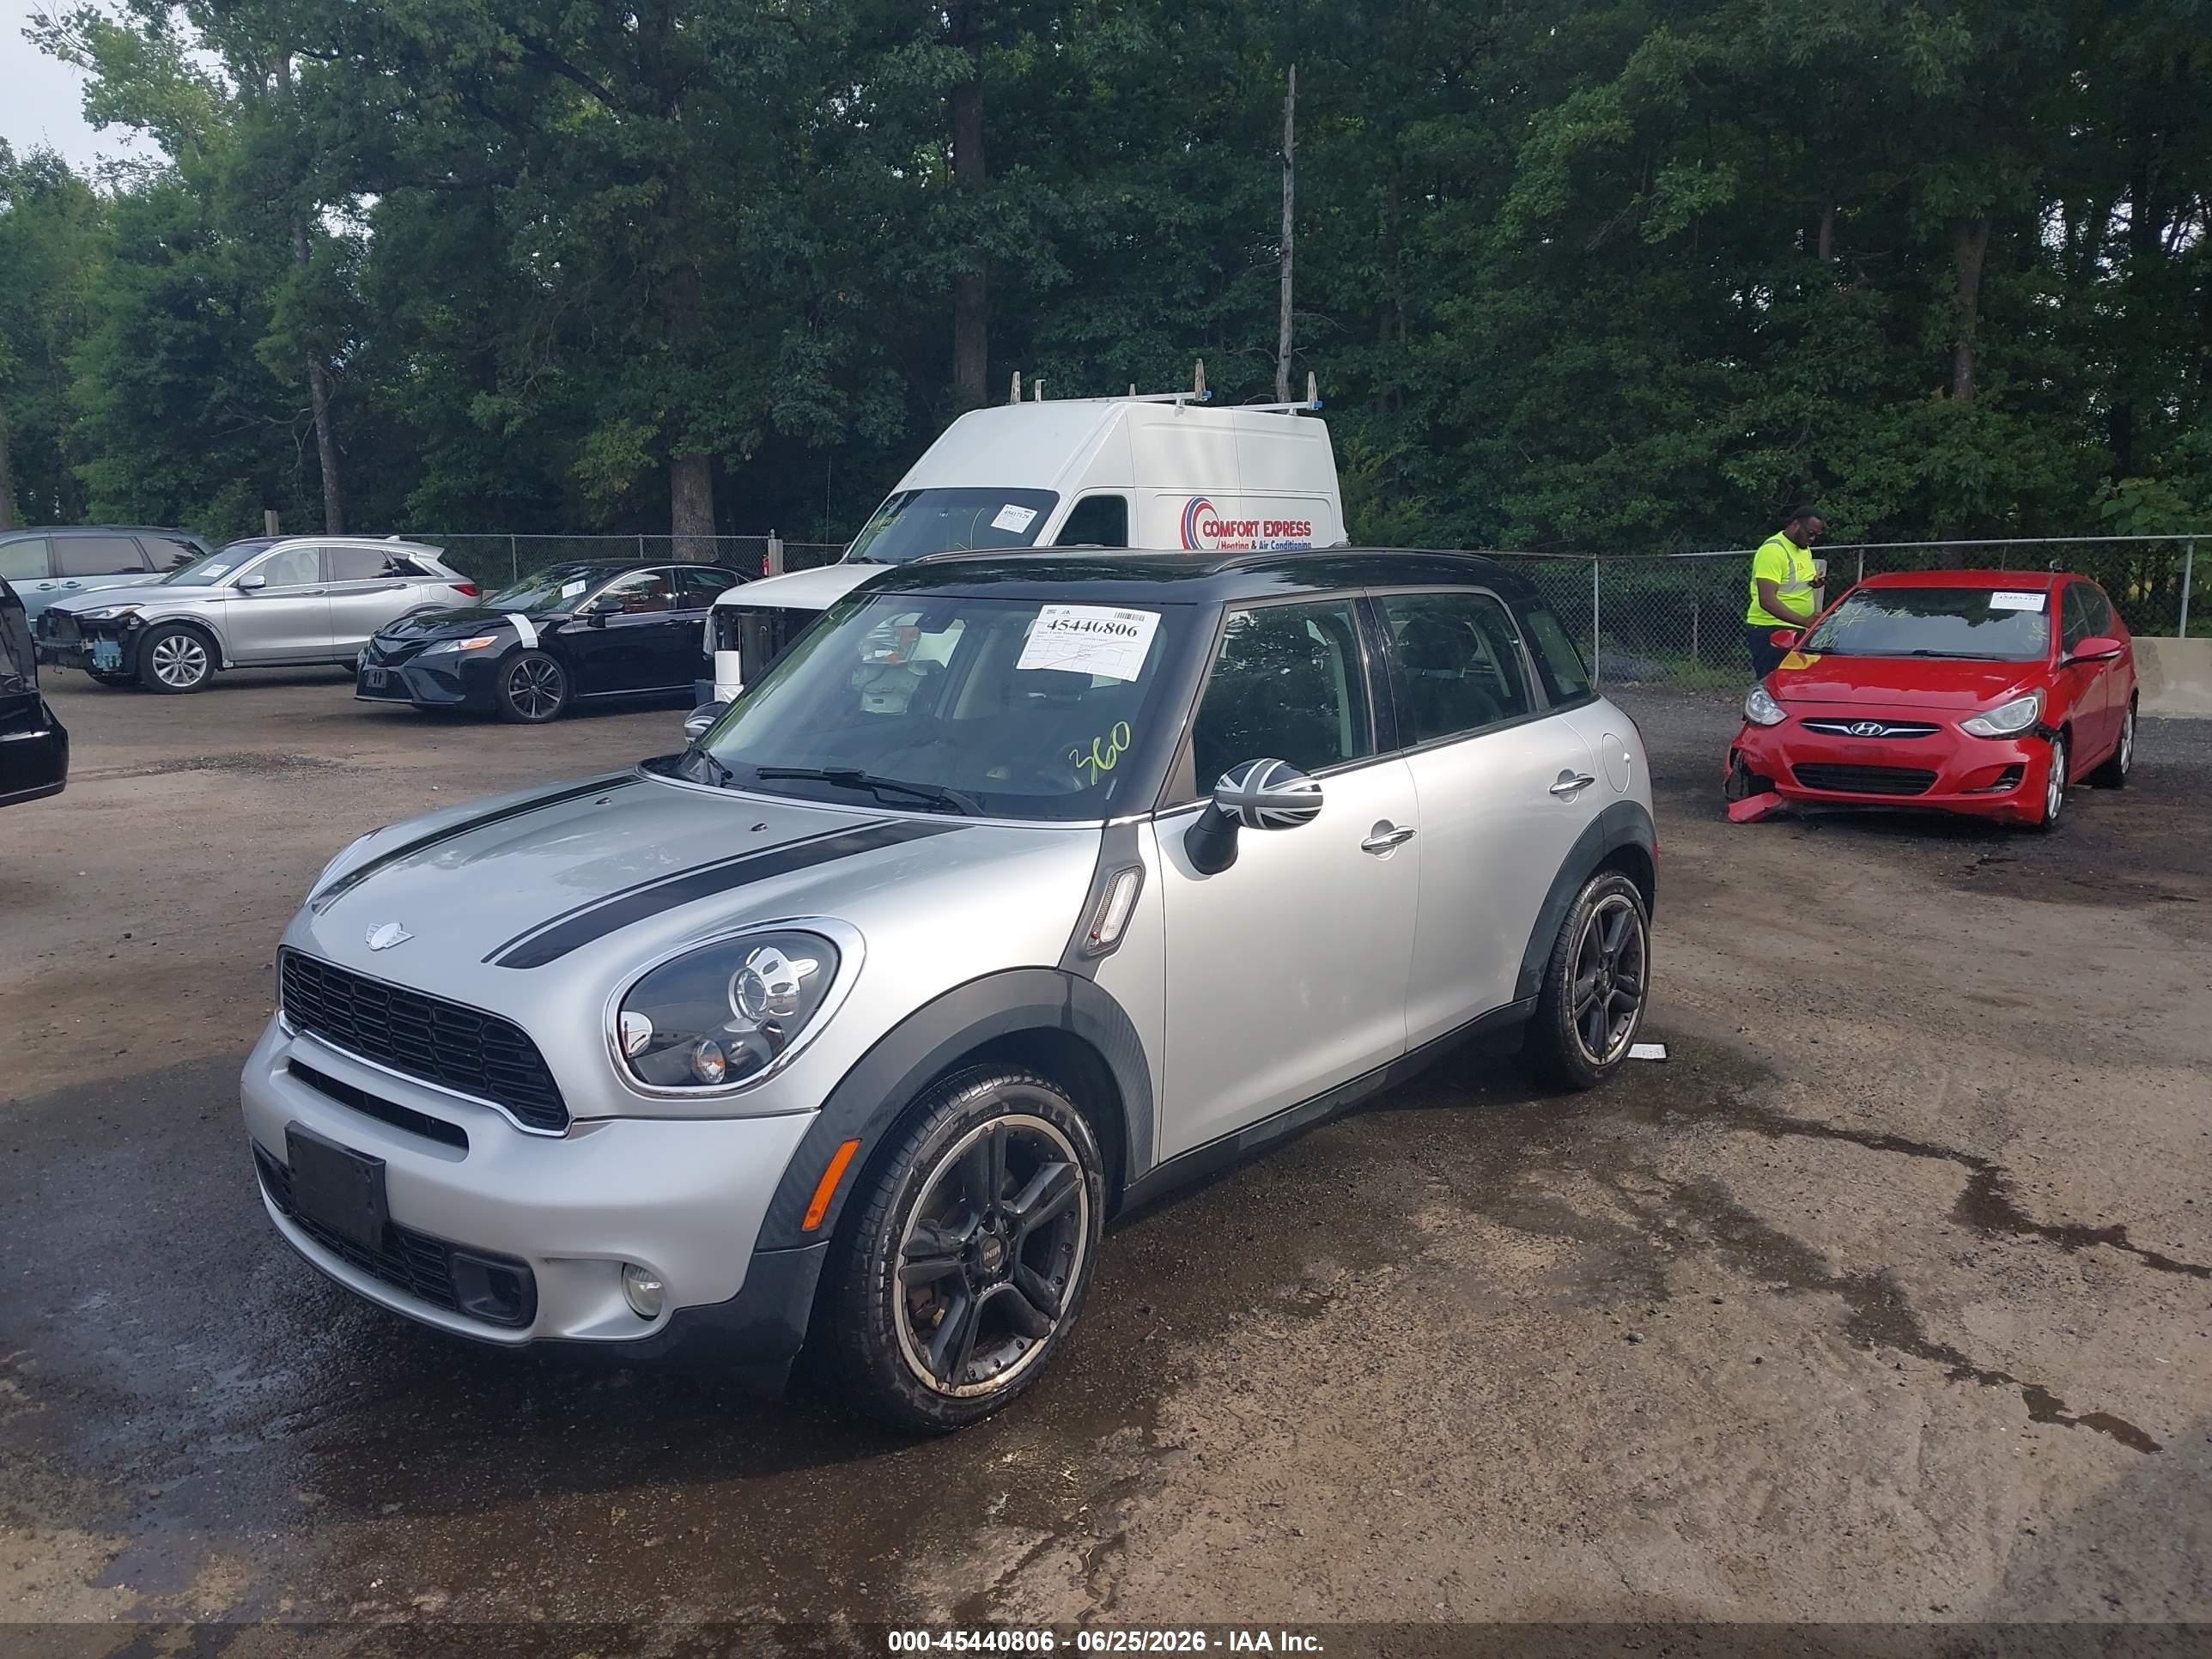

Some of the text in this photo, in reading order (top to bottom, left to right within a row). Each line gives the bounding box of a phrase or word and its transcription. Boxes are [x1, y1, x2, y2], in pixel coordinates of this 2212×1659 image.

[1203, 520, 1312, 537] COMFORT EXPRESS
[1251, 540, 1257, 550] &
[1259, 540, 1268, 550] Air
[1069, 720, 1131, 787] 360
